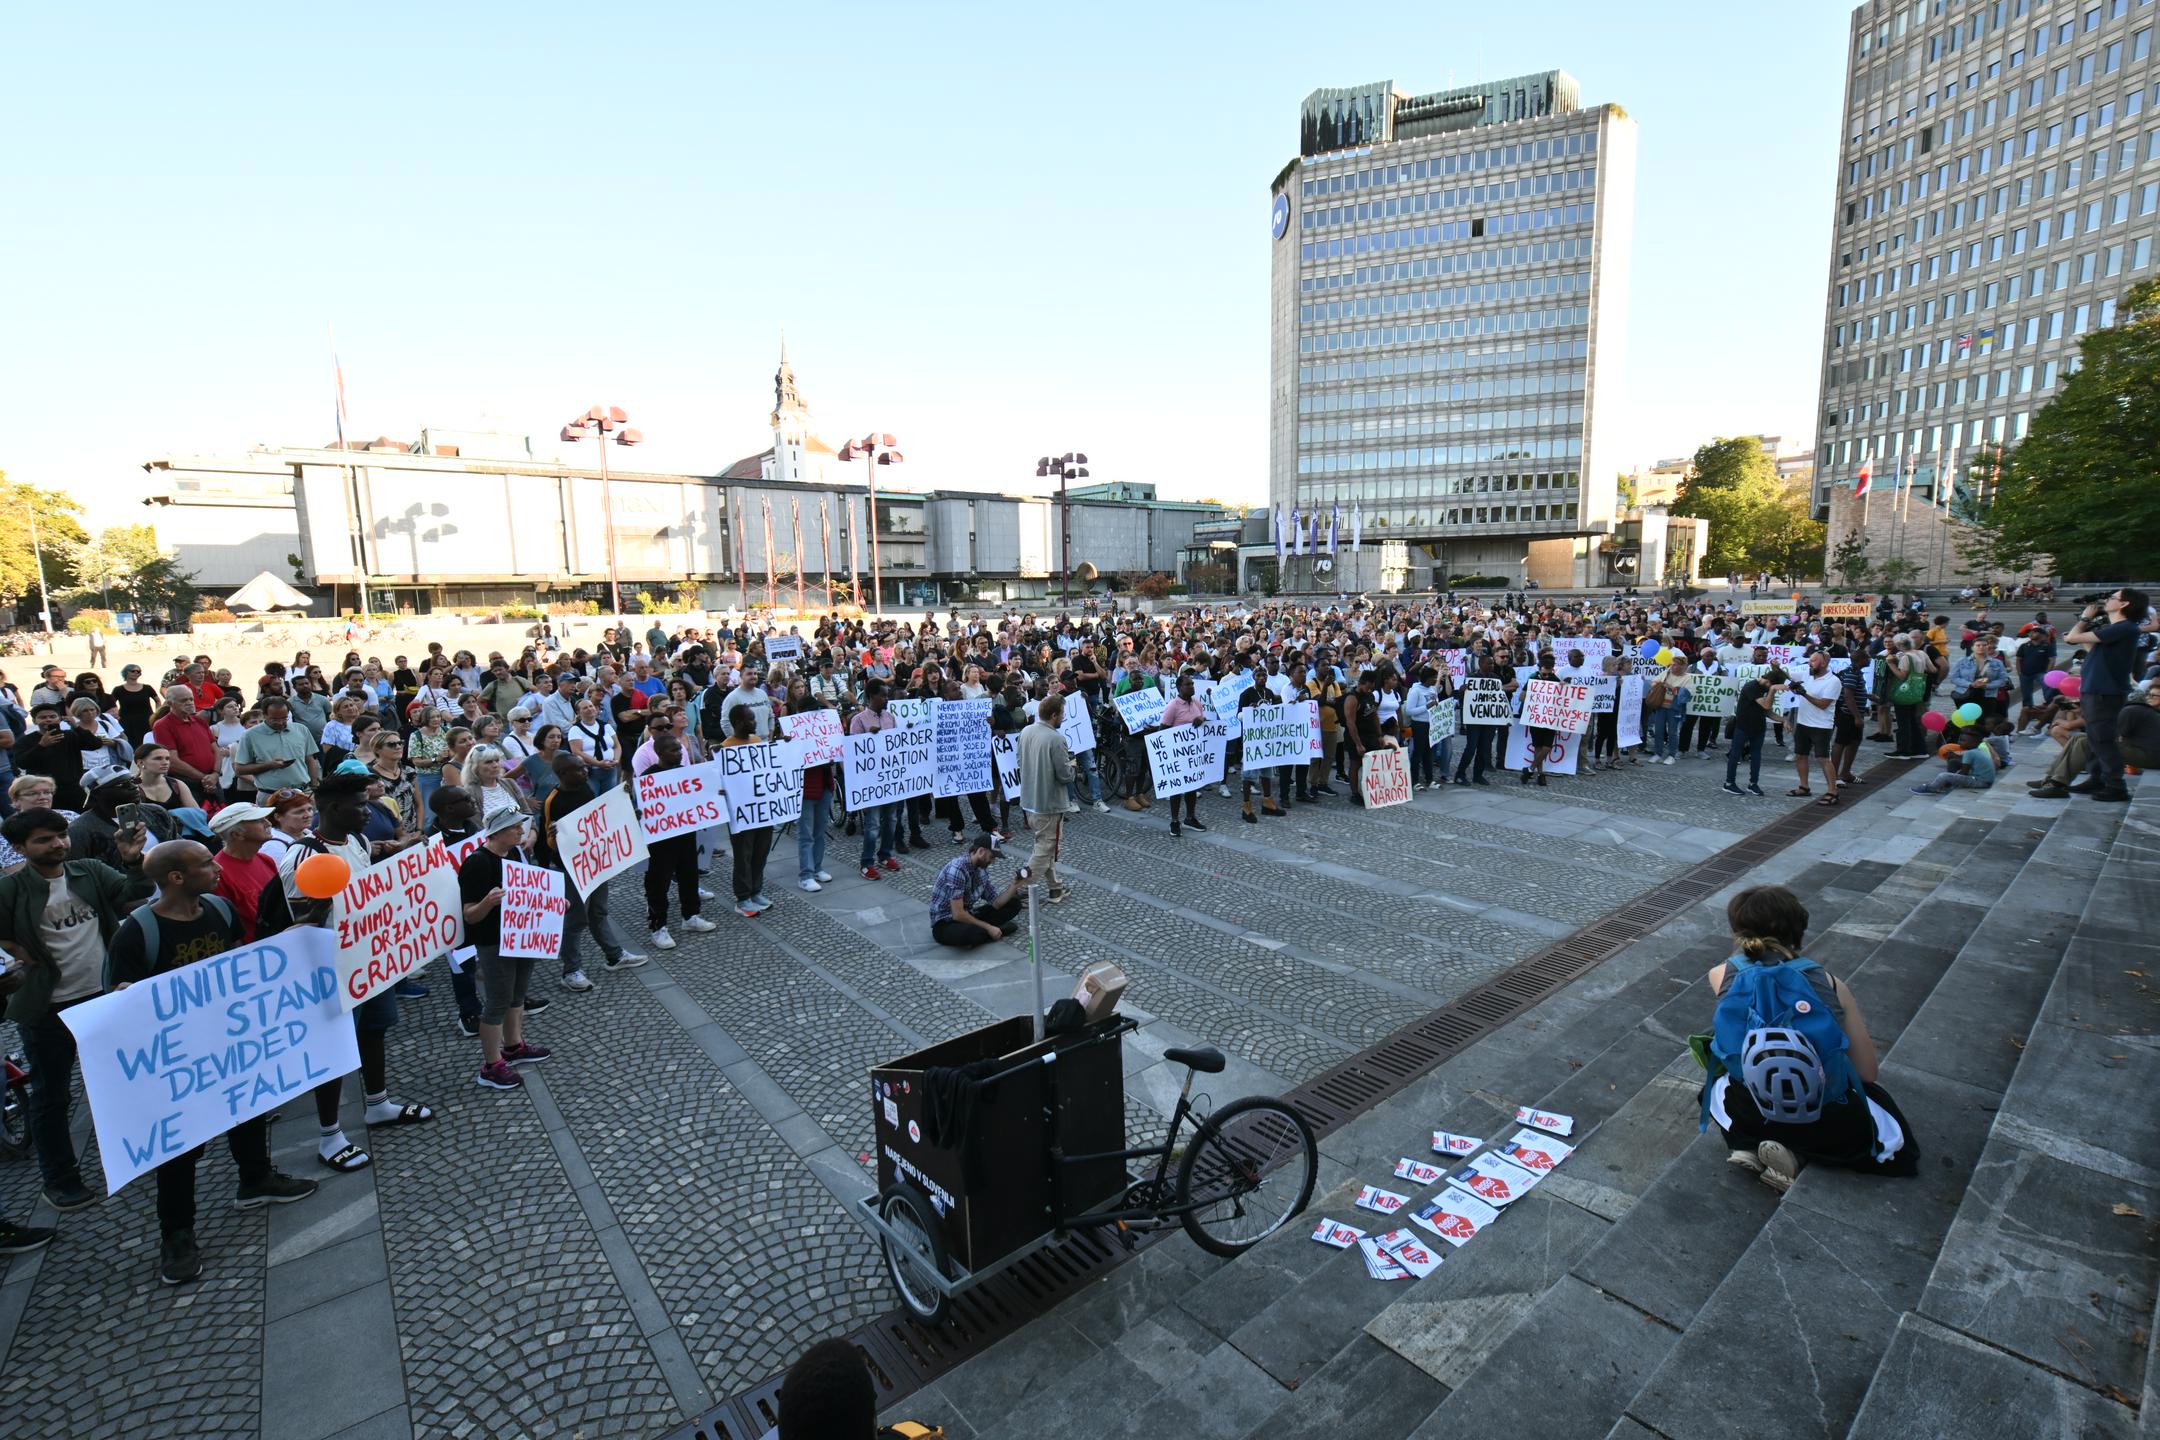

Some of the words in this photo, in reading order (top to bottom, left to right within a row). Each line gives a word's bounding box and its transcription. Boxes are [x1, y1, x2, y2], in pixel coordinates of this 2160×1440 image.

[1556, 641, 1577, 649] THERE
[1594, 641, 1607, 649] NO
[1468, 680, 1479, 691] EL
[1694, 685, 1734, 697] STAND
[1526, 703, 1539, 714] NE
[1542, 704, 1590, 722] DELAVSKE
[1529, 694, 1570, 708] KRIVICE
[1692, 703, 1722, 713] FALL
[1252, 706, 1285, 724] PROTI
[1529, 713, 1577, 731] PRAVICE
[815, 737, 831, 748] NE
[854, 737, 876, 756] NO
[885, 728, 933, 752] BORDER
[1150, 736, 1166, 751] WE
[1173, 727, 1200, 744] MUST
[1203, 724, 1228, 738] DARE
[1243, 722, 1310, 744] BIROKRATSKEMU
[855, 757, 876, 775] NO
[881, 748, 929, 769] NATION
[1156, 750, 1168, 763] TO
[1173, 740, 1208, 759] INVENT
[1245, 740, 1304, 762] RASIZMU
[877, 766, 907, 783] STOP
[1159, 760, 1181, 777] THE
[1188, 752, 1216, 769] FUTURE
[639, 774, 655, 789] NO
[947, 774, 954, 784] A
[957, 770, 984, 781] VLADI
[956, 779, 993, 793] ŠTEVILKA
[1183, 771, 1206, 784] RACISM
[1365, 773, 1386, 791] NAJ
[1391, 770, 1409, 787] VSI
[641, 777, 703, 802] FAMILIES
[852, 774, 934, 806] DEPORTATION
[1370, 786, 1409, 807] NARODI
[643, 802, 666, 819] NO
[644, 801, 719, 836] WORKERS
[577, 803, 608, 847] SMRT
[572, 825, 632, 891] FAŠIZMU
[506, 863, 551, 891] DELAVCI
[342, 865, 393, 915] TUKAJ
[506, 888, 566, 917] USTVARJAMO
[338, 902, 394, 950] ŽIVIMO
[404, 882, 427, 907] TO
[503, 909, 543, 930] PROFIT
[371, 900, 439, 957] DRŽAVO
[503, 932, 516, 951] NE
[520, 932, 560, 955] LUKNJE
[348, 914, 457, 1000] GRADIMO
[151, 945, 288, 1021] UNITED
[117, 1023, 184, 1081] WE
[226, 965, 338, 1036] STAND
[160, 1021, 309, 1102] DEVIDED
[122, 1110, 186, 1168] WE
[223, 1050, 331, 1117] FALL
[333, 1145, 363, 1164] FILA
[884, 1144, 917, 1179] NAREJENO
